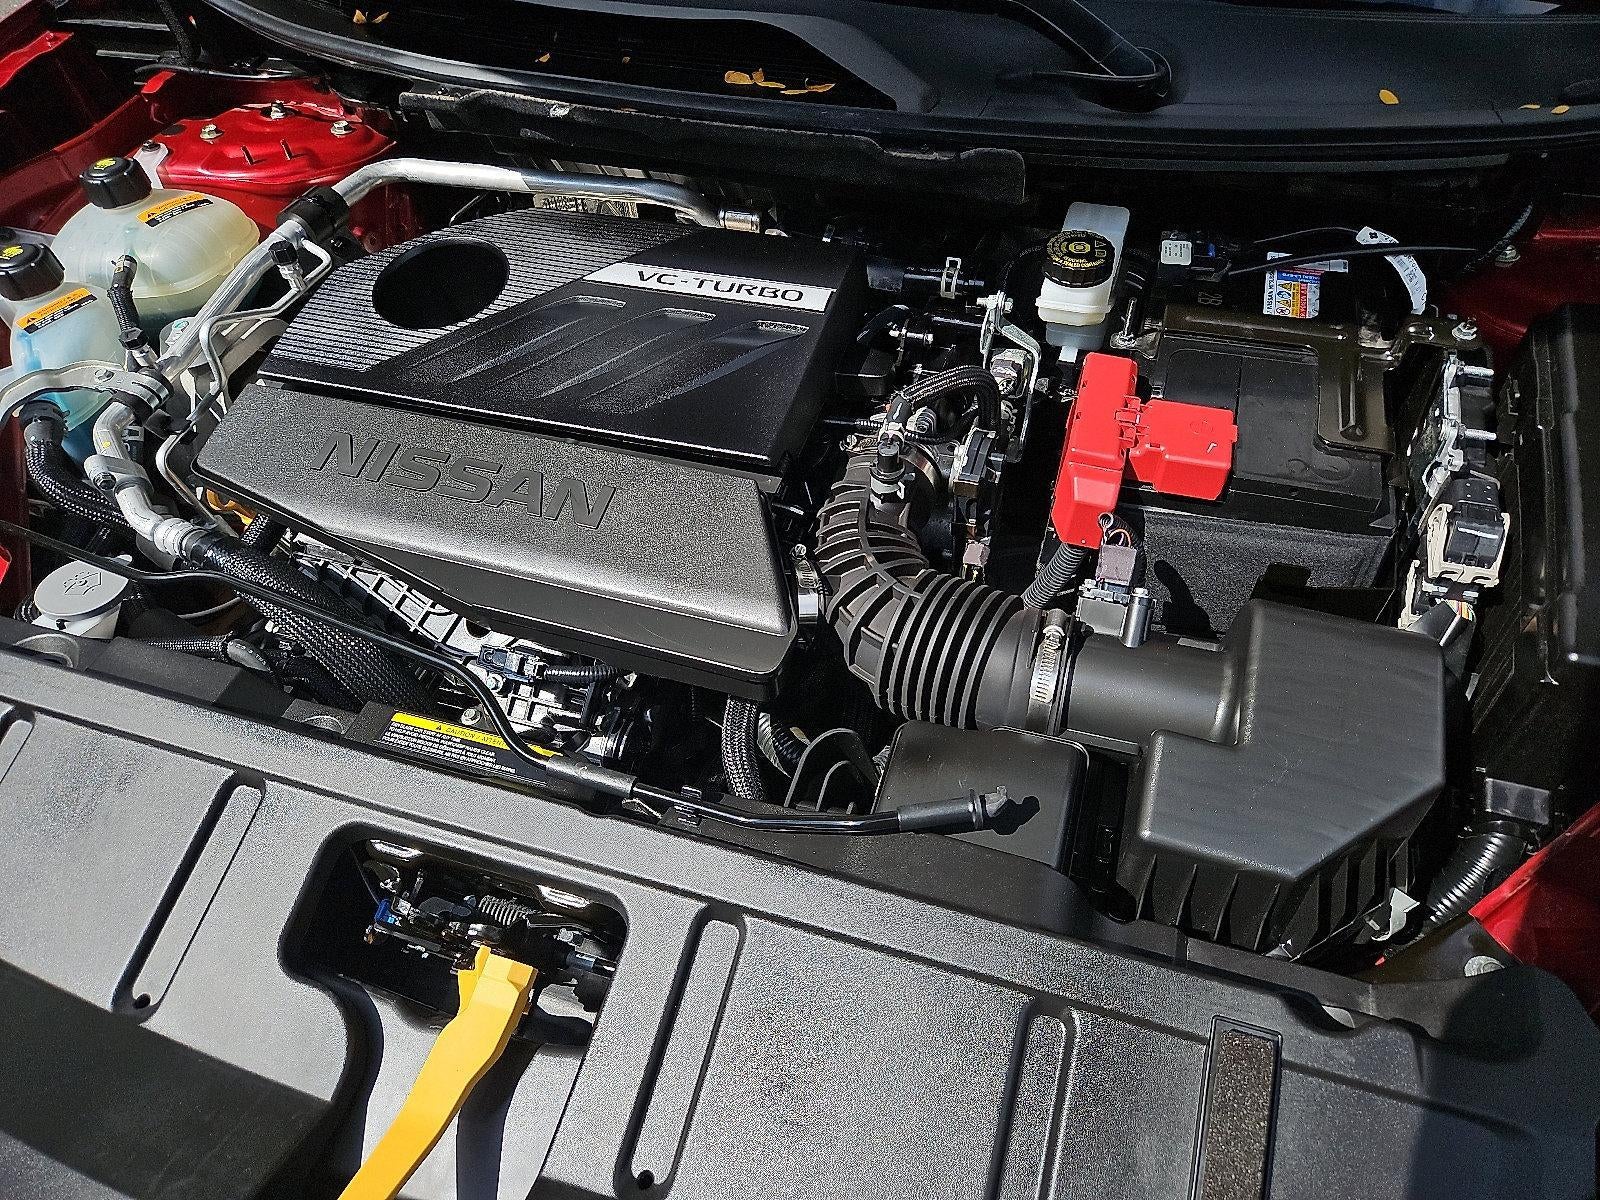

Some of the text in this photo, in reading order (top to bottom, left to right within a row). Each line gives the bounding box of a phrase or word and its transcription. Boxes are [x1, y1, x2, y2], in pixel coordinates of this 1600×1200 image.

[638, 270, 803, 301] VC-TURBO
[311, 431, 616, 529] NISSAN
[445, 727, 475, 738] CAUTION
